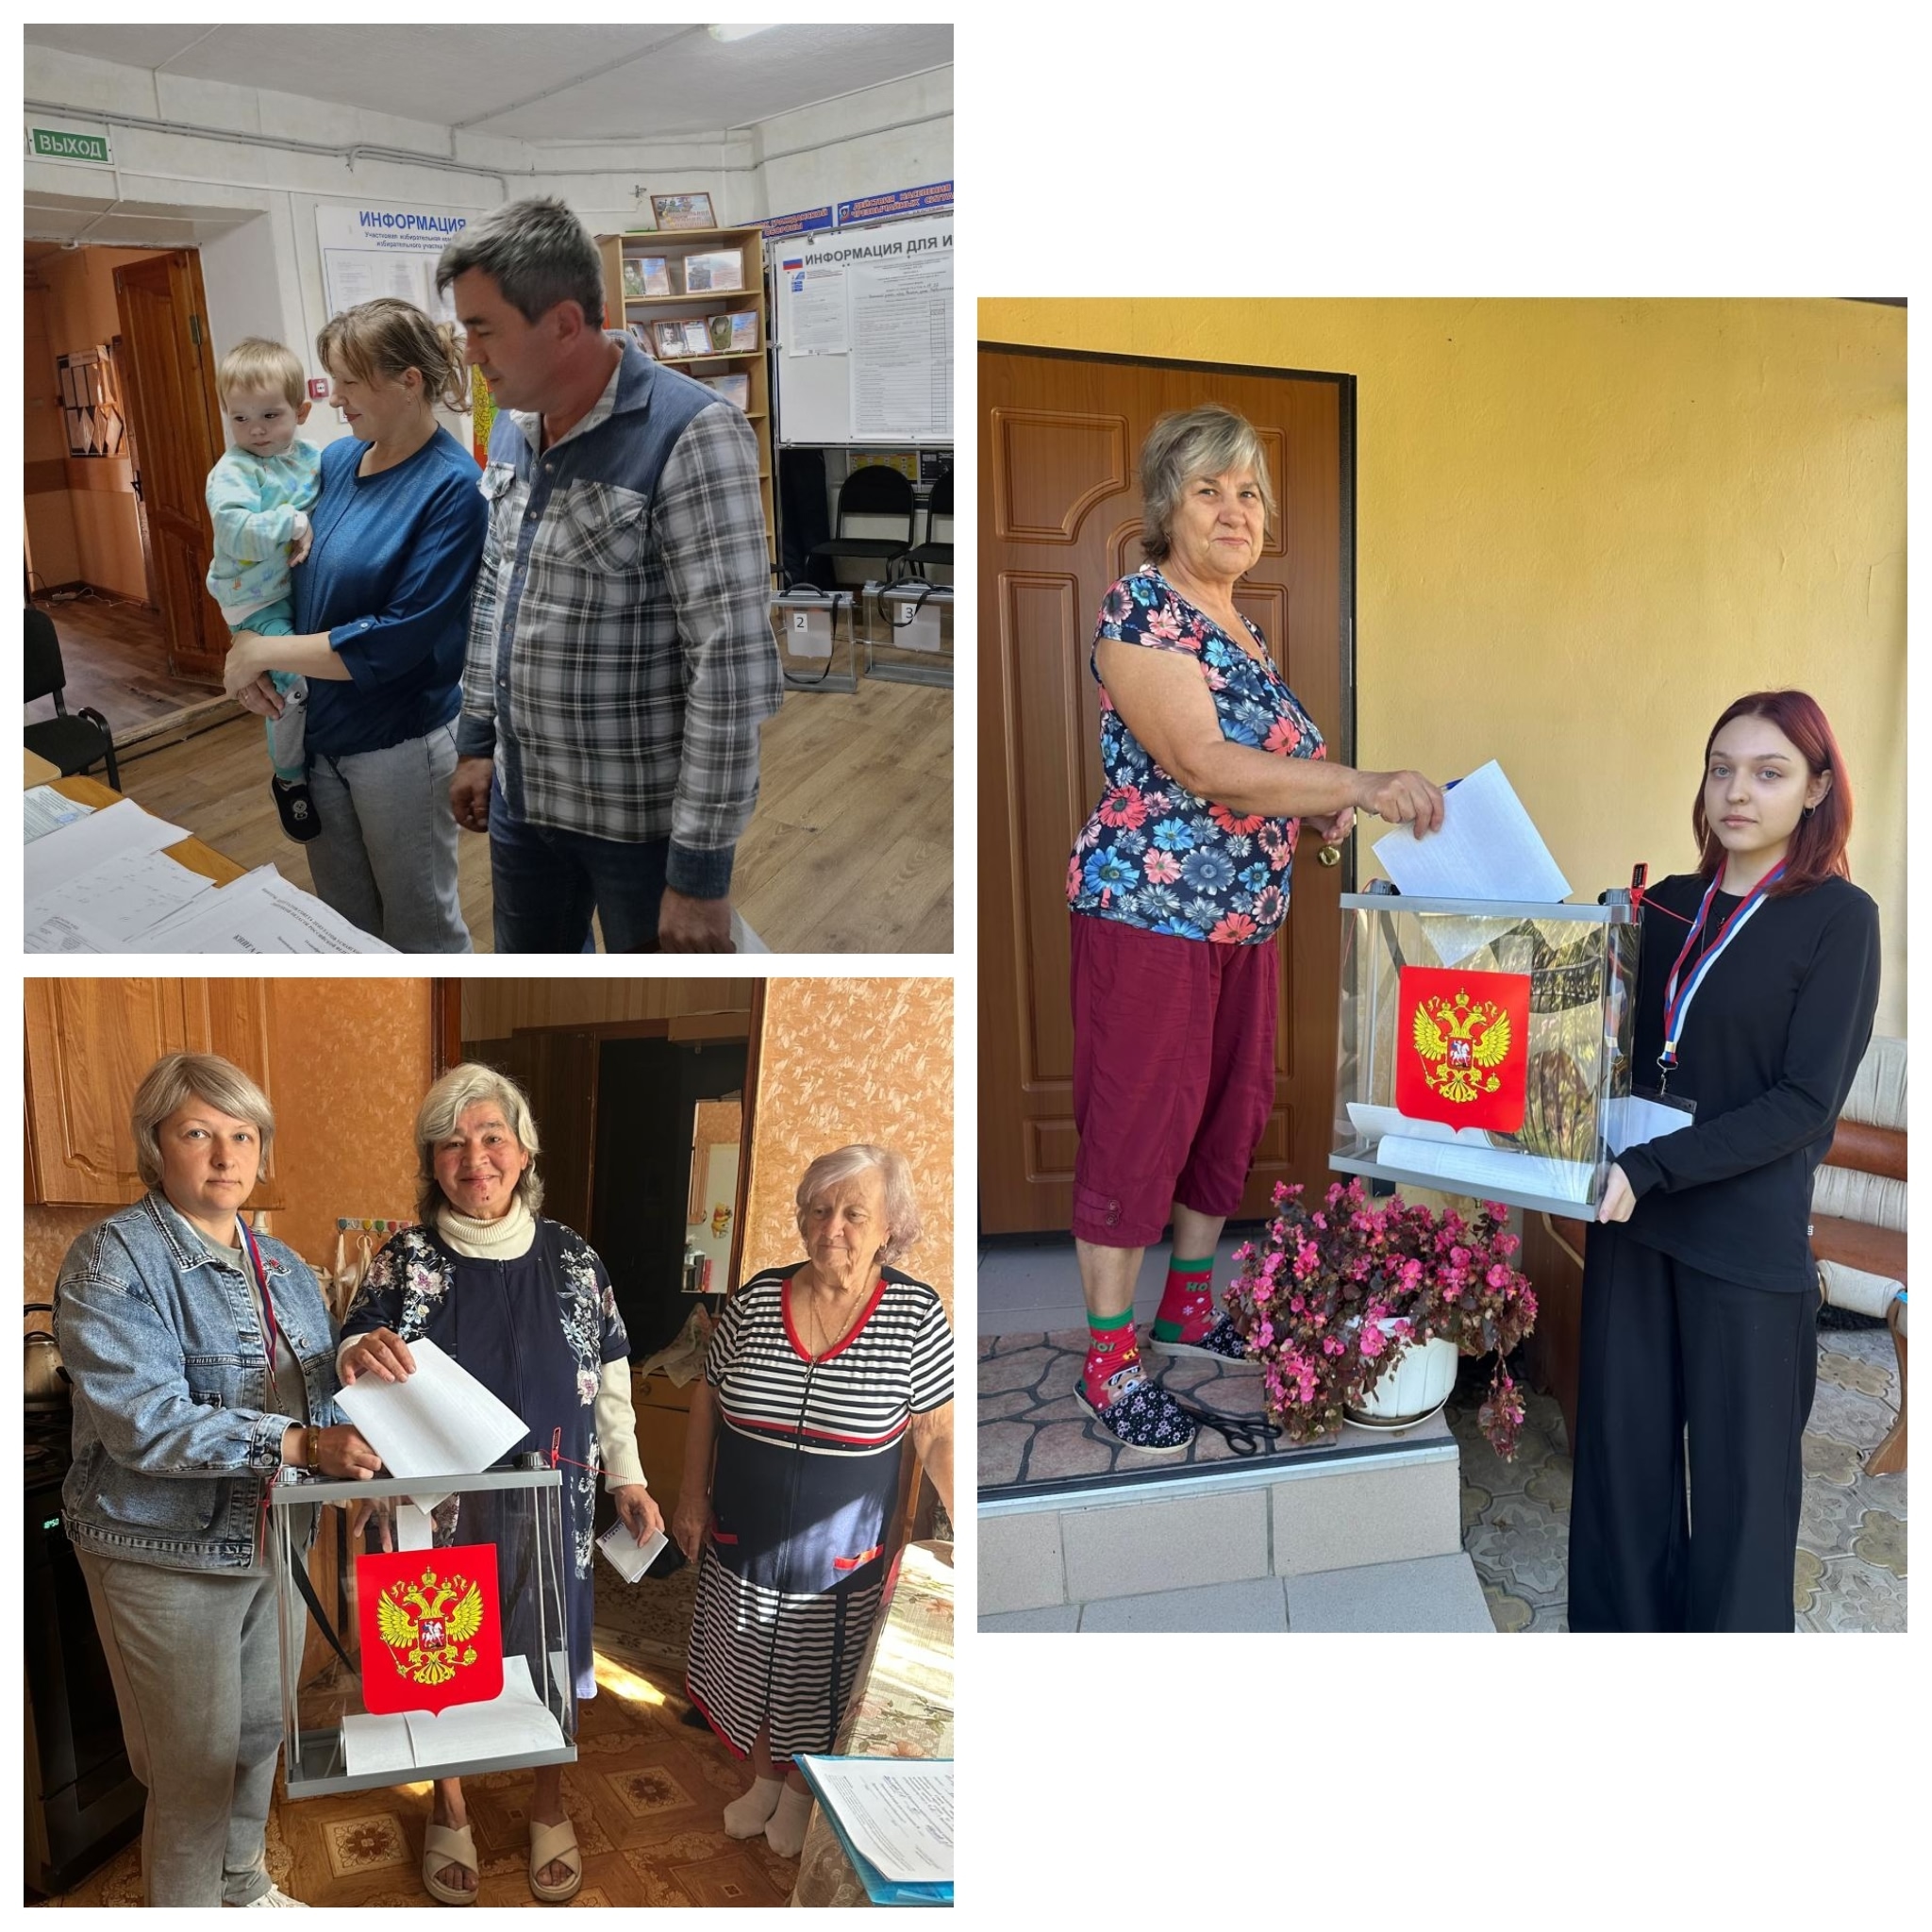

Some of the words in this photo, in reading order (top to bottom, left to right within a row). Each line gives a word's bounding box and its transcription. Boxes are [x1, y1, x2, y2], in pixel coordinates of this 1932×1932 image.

[40, 134, 101, 158] ВЫХОД
[359, 211, 466, 234] ИНФОРМАЦИЯ
[805, 242, 903, 266] ИНФОРМАЦИЯ
[907, 237, 938, 254] ДЛЯ
[796, 616, 805, 629] 2
[906, 607, 914, 620] 3
